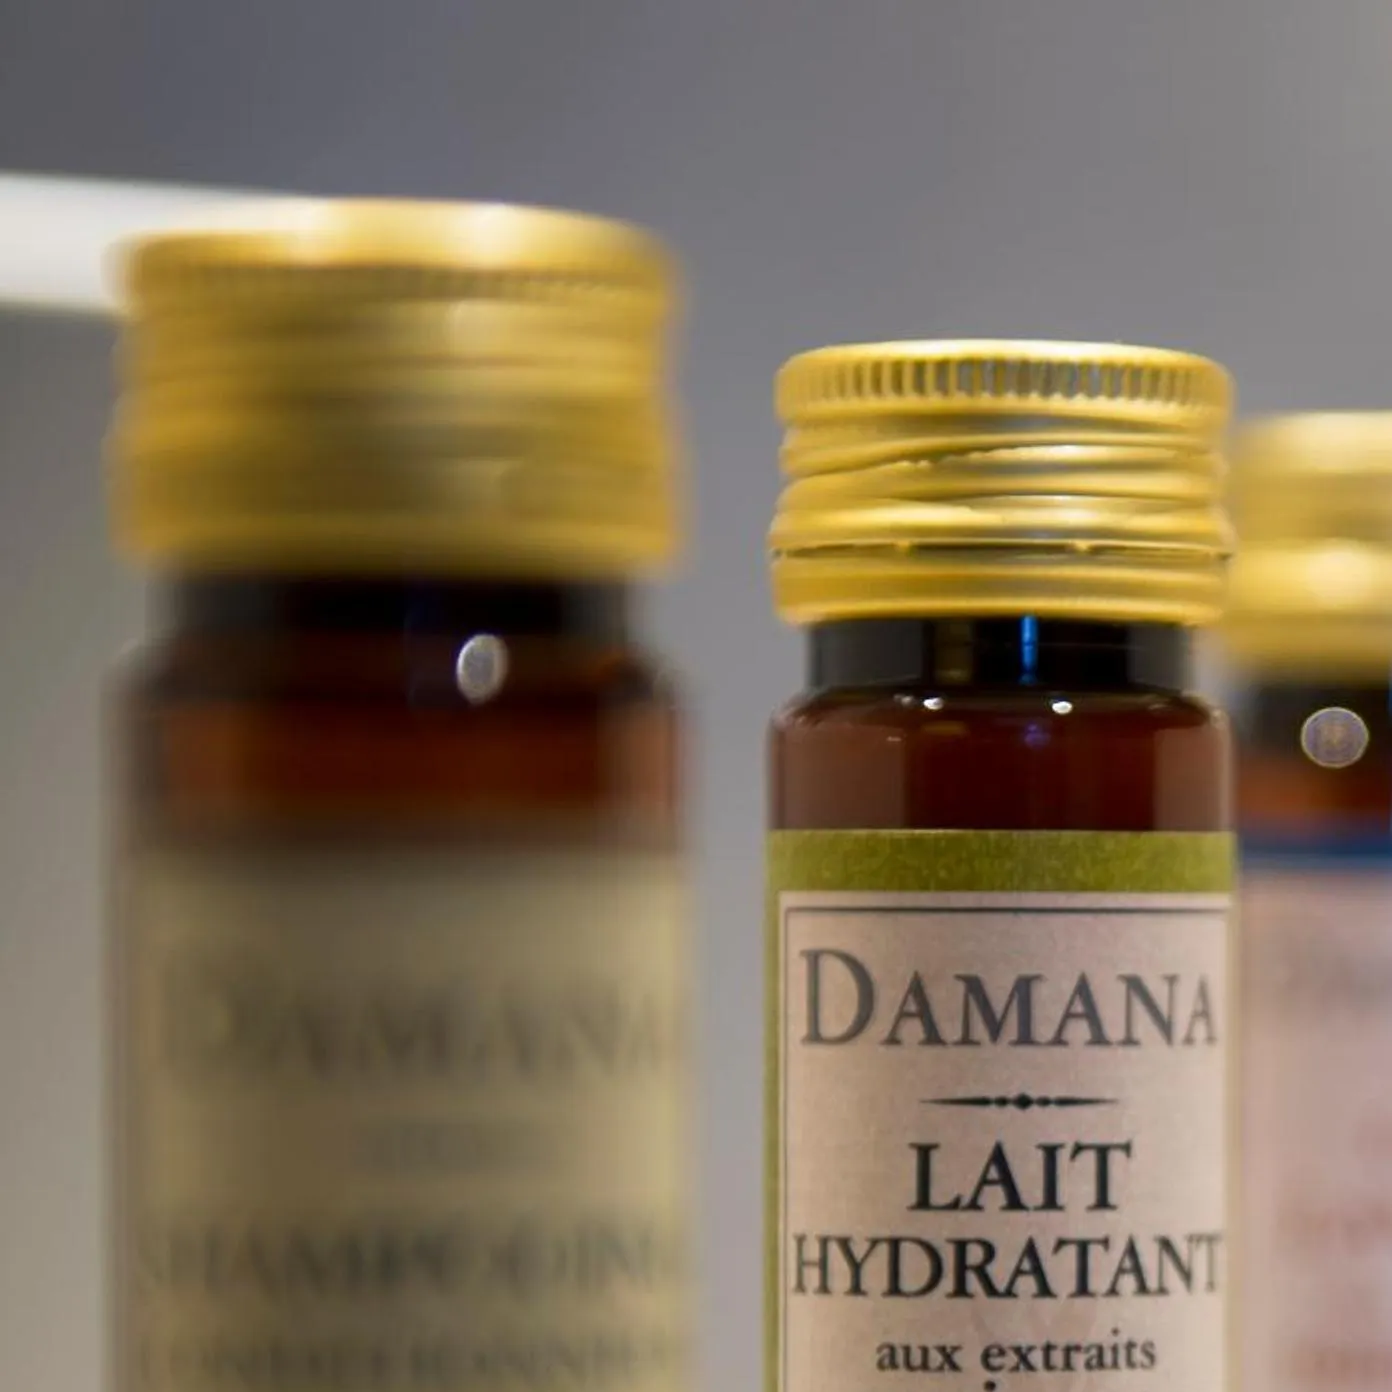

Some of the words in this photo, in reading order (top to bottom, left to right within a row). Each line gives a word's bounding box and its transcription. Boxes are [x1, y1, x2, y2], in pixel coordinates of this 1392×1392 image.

[800, 949, 1217, 1047] DAMANA
[906, 1141, 1132, 1212] LAIT
[793, 1233, 1223, 1299] HYDRATANT
[876, 1342, 963, 1372] aux
[980, 1328, 1156, 1373] extraits
